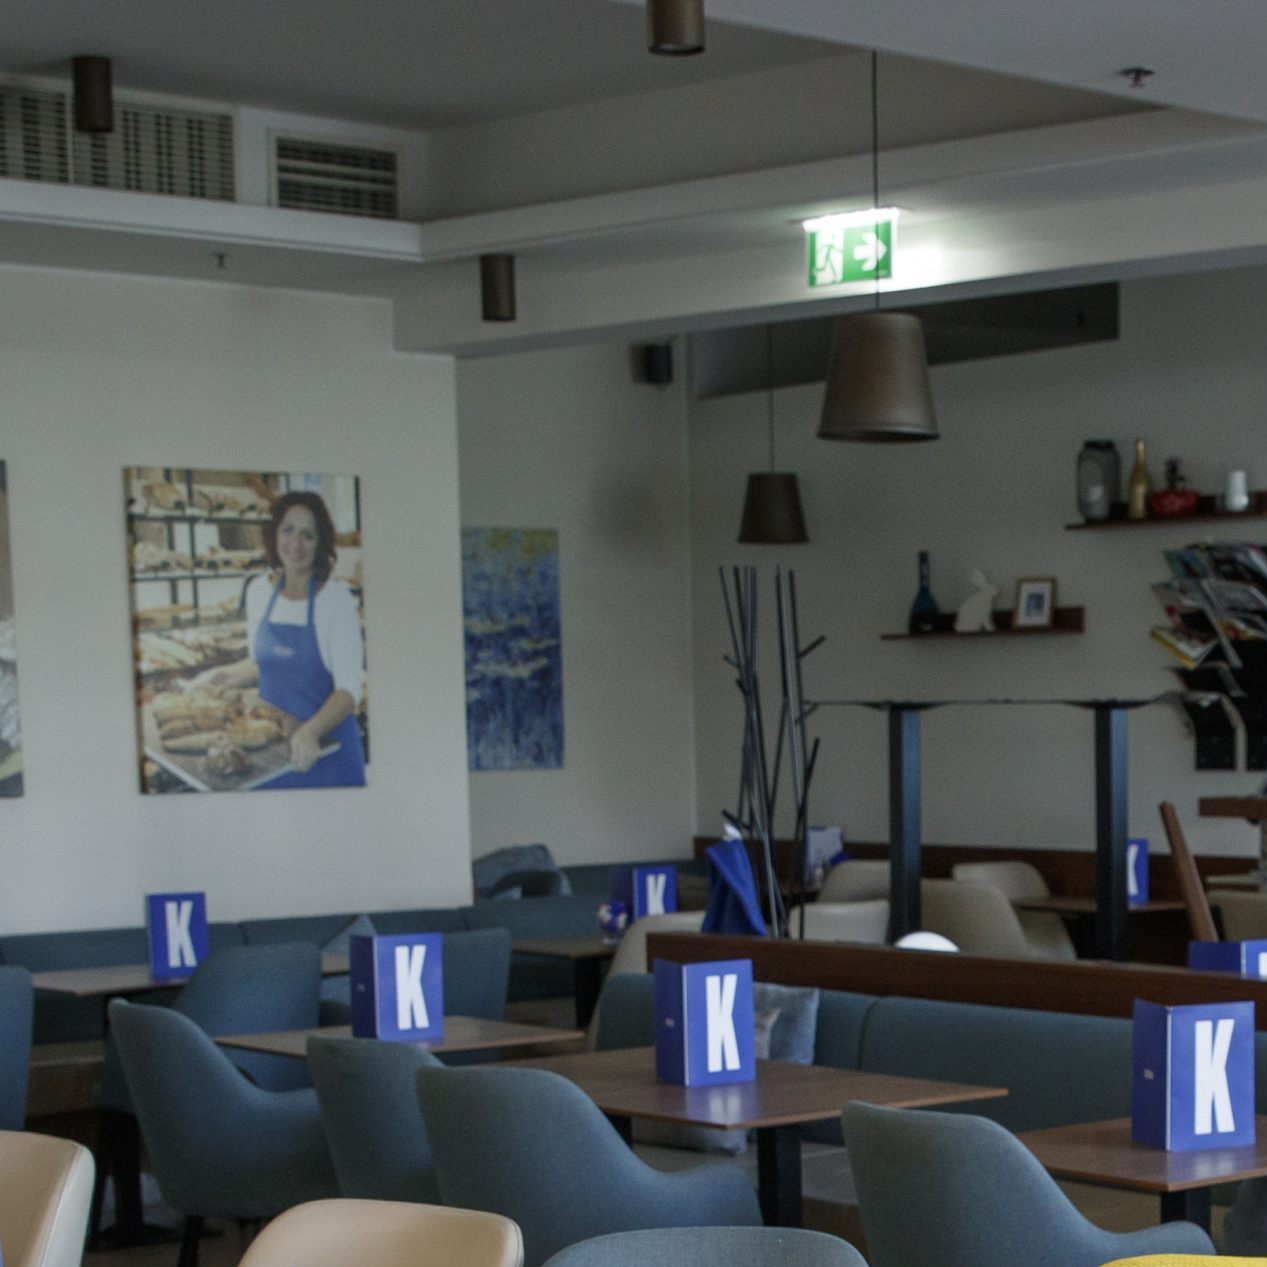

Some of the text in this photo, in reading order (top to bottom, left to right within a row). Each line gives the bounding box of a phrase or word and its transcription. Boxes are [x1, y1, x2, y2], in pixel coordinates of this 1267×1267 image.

[165, 900, 198, 969] K
[395, 943, 430, 1031] K
[705, 973, 741, 1073] K
[1194, 1018, 1236, 1136] K
